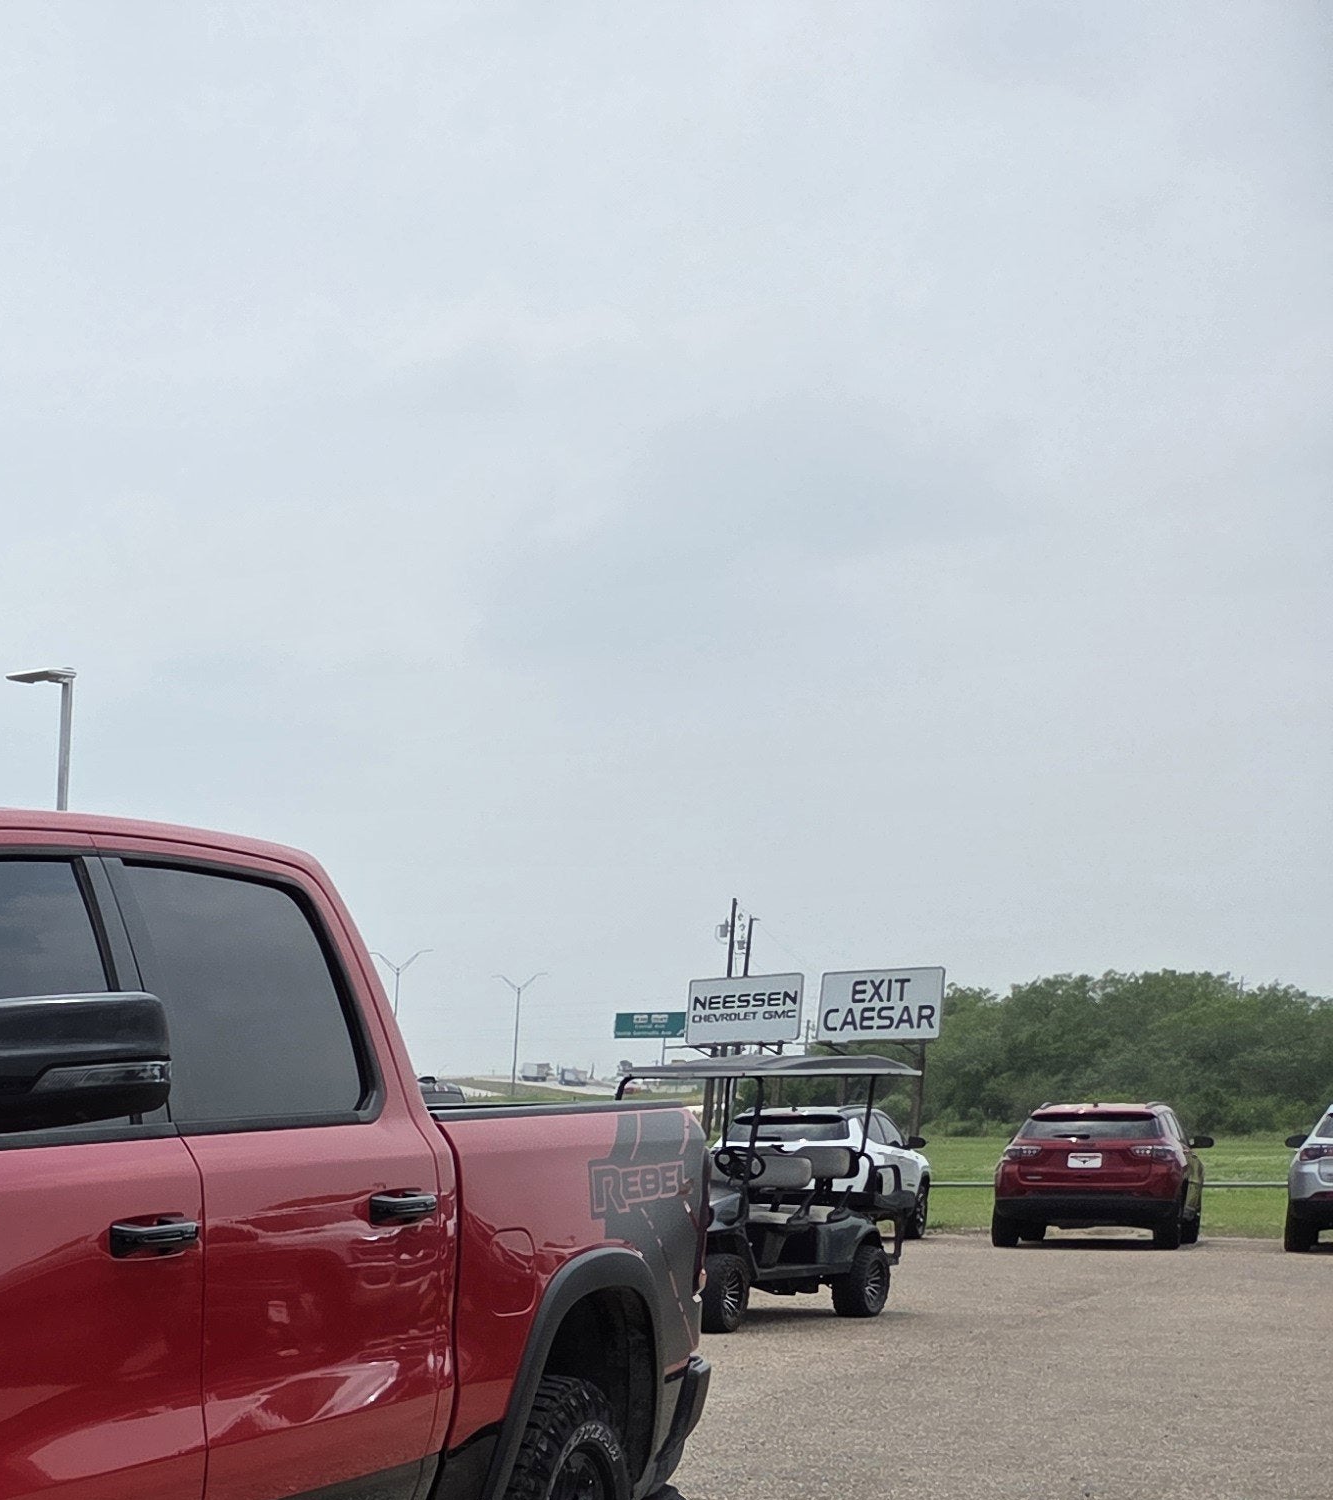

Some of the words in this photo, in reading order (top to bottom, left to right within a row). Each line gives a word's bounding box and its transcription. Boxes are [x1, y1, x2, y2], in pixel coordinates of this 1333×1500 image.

[692, 990, 798, 1011] NEESSEN
[851, 978, 911, 1004] EXIT
[692, 1011, 758, 1024] CHEVROLET
[762, 1009, 797, 1020] GMC
[823, 1004, 936, 1032] CAESAR
[591, 1161, 692, 1213] REBEL
